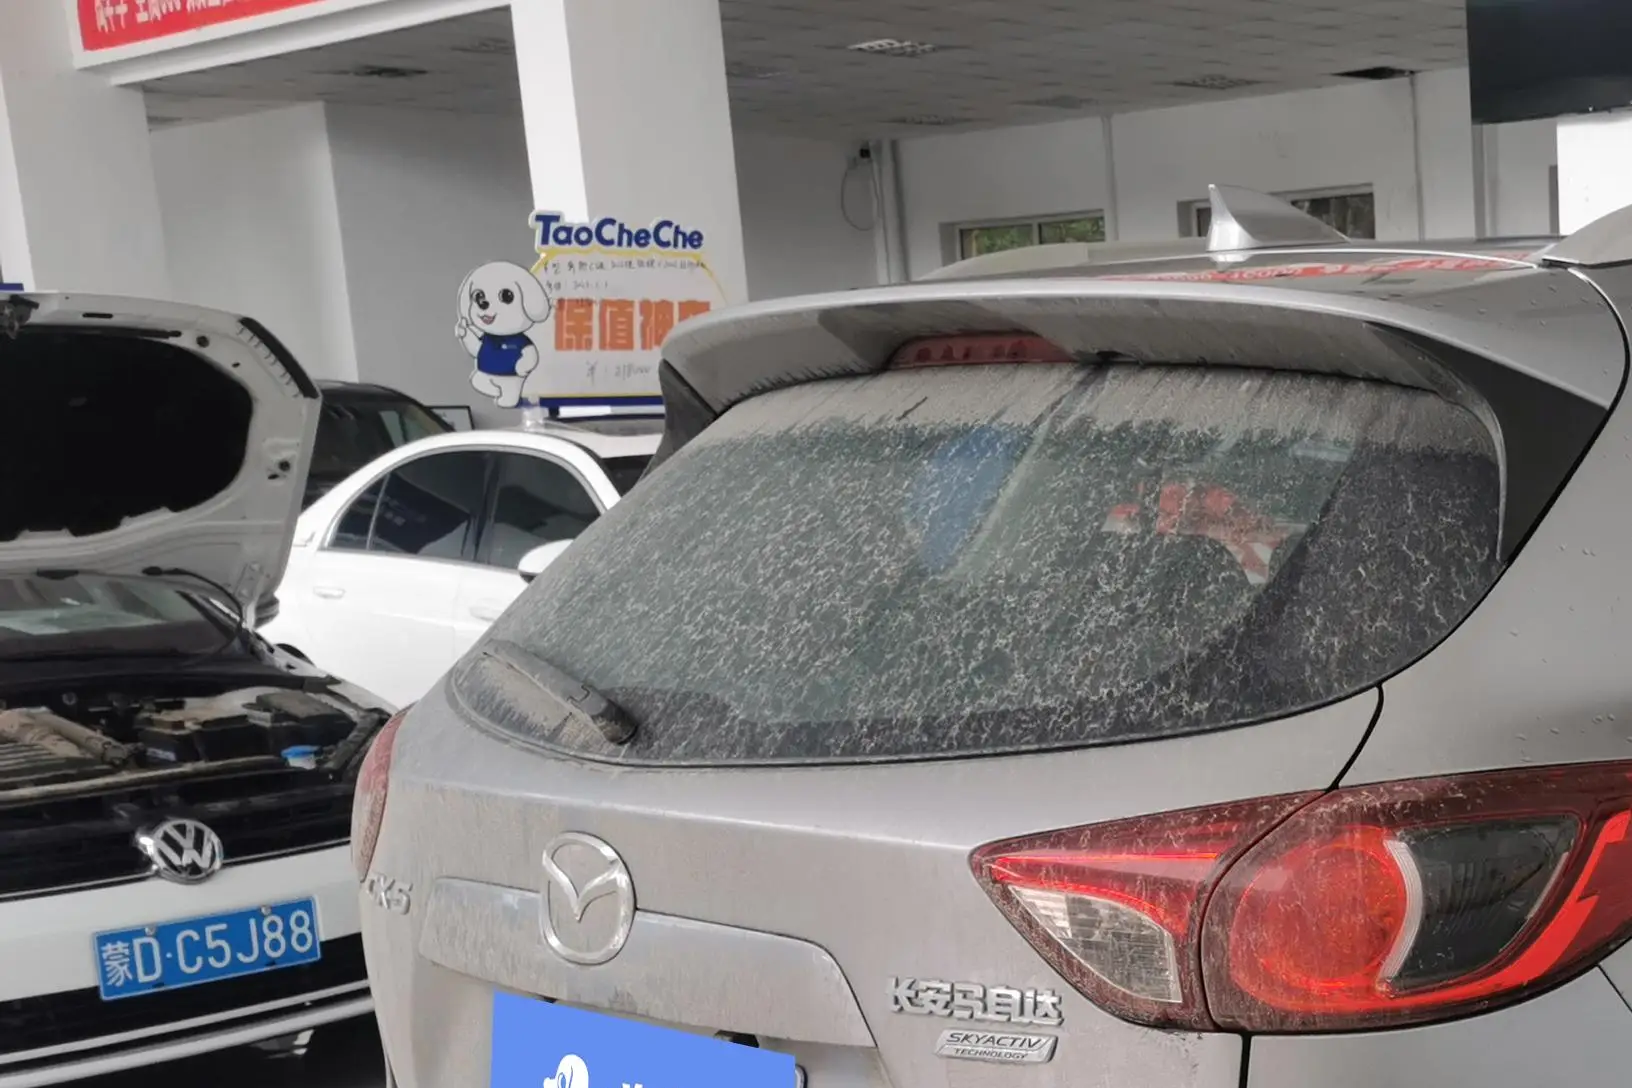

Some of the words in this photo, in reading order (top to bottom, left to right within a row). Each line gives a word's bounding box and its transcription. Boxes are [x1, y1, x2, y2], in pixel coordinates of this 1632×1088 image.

[535, 214, 704, 249] TaoCheChe
[888, 976, 1064, 1026] 长安马自达
[947, 1032, 1042, 1049] SKYACTIV
[954, 1047, 1028, 1060] TECHNOLOGY
